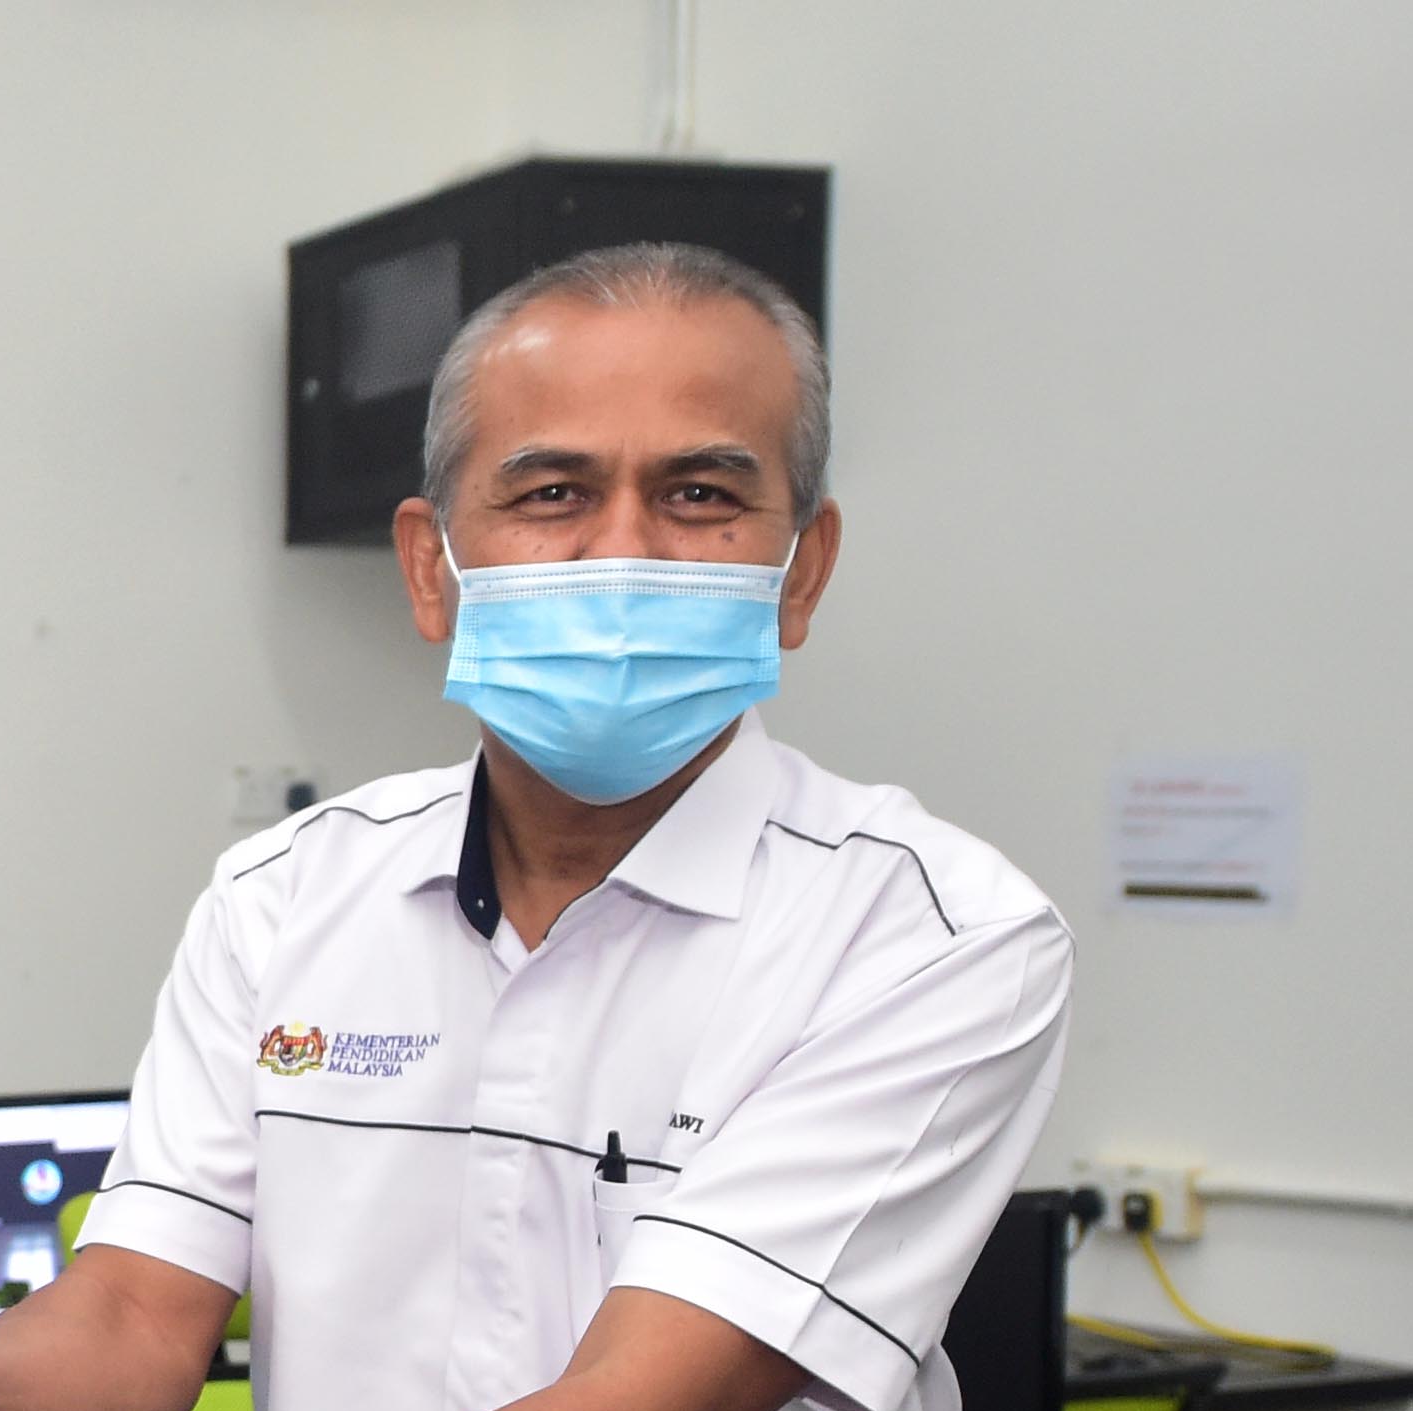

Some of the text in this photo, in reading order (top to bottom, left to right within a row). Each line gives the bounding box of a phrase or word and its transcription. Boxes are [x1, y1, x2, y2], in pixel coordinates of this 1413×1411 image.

[335, 1032, 441, 1048] KEMENTERIAN
[330, 1046, 426, 1062] PENDIDIKAN
[327, 1060, 404, 1077] MALAYSIA
[668, 1110, 705, 1134] AWI
